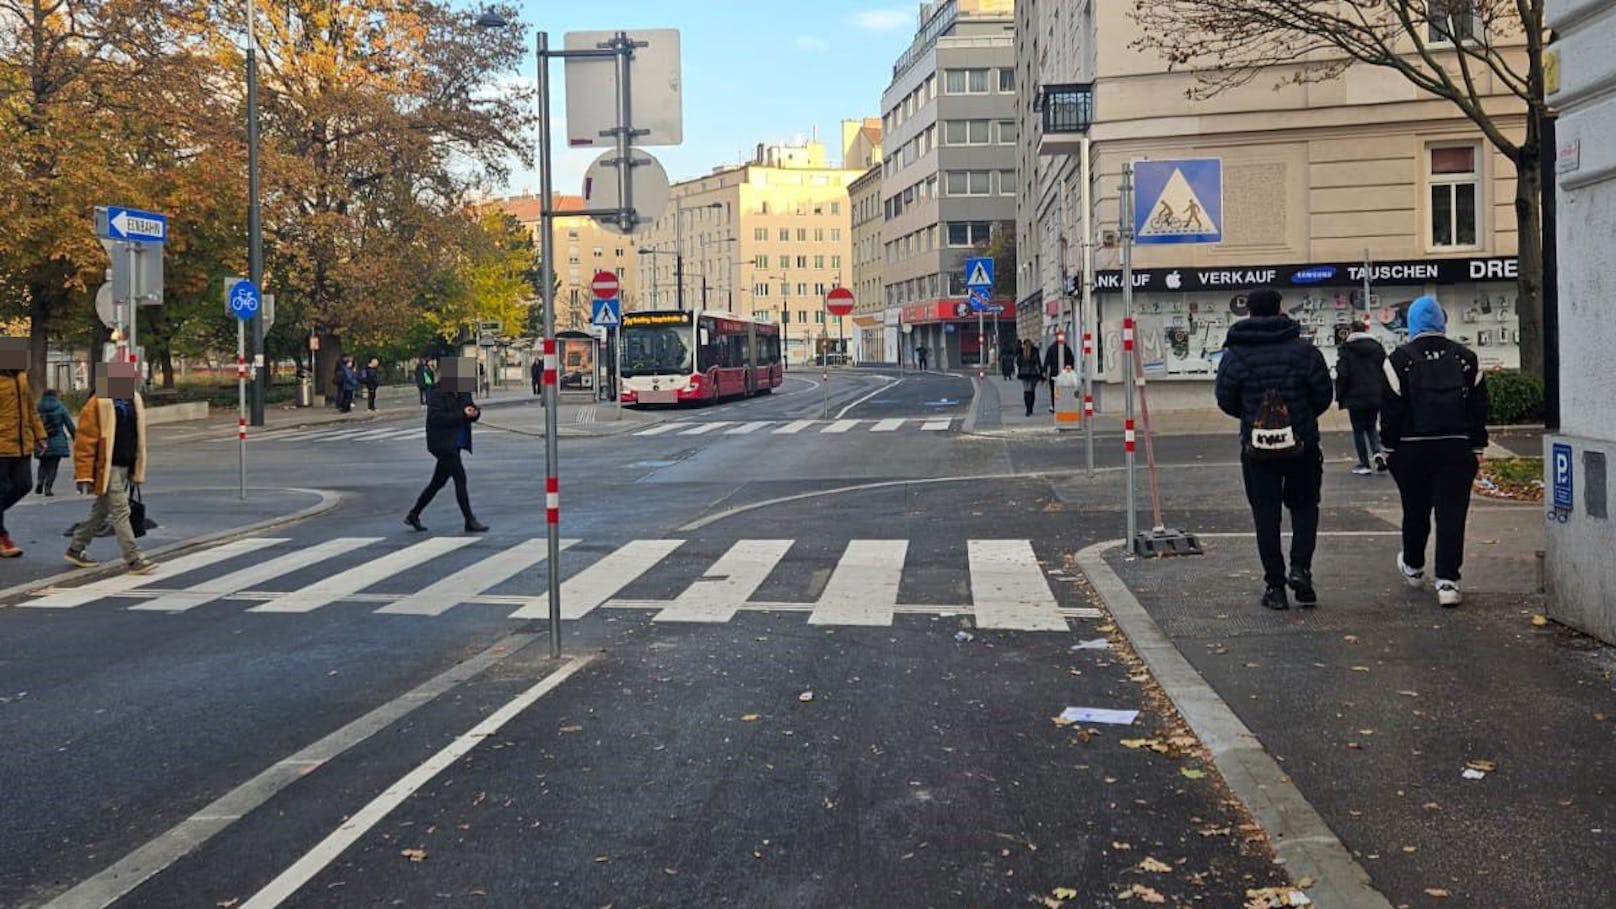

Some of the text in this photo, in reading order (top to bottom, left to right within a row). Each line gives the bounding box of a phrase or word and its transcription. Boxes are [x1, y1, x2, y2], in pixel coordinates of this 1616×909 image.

[128, 219, 160, 235] EINBAHN
[1094, 274, 1151, 288] NKUF
[1198, 270, 1276, 284] VERKAUF
[1347, 265, 1438, 280] TAUSCHEN
